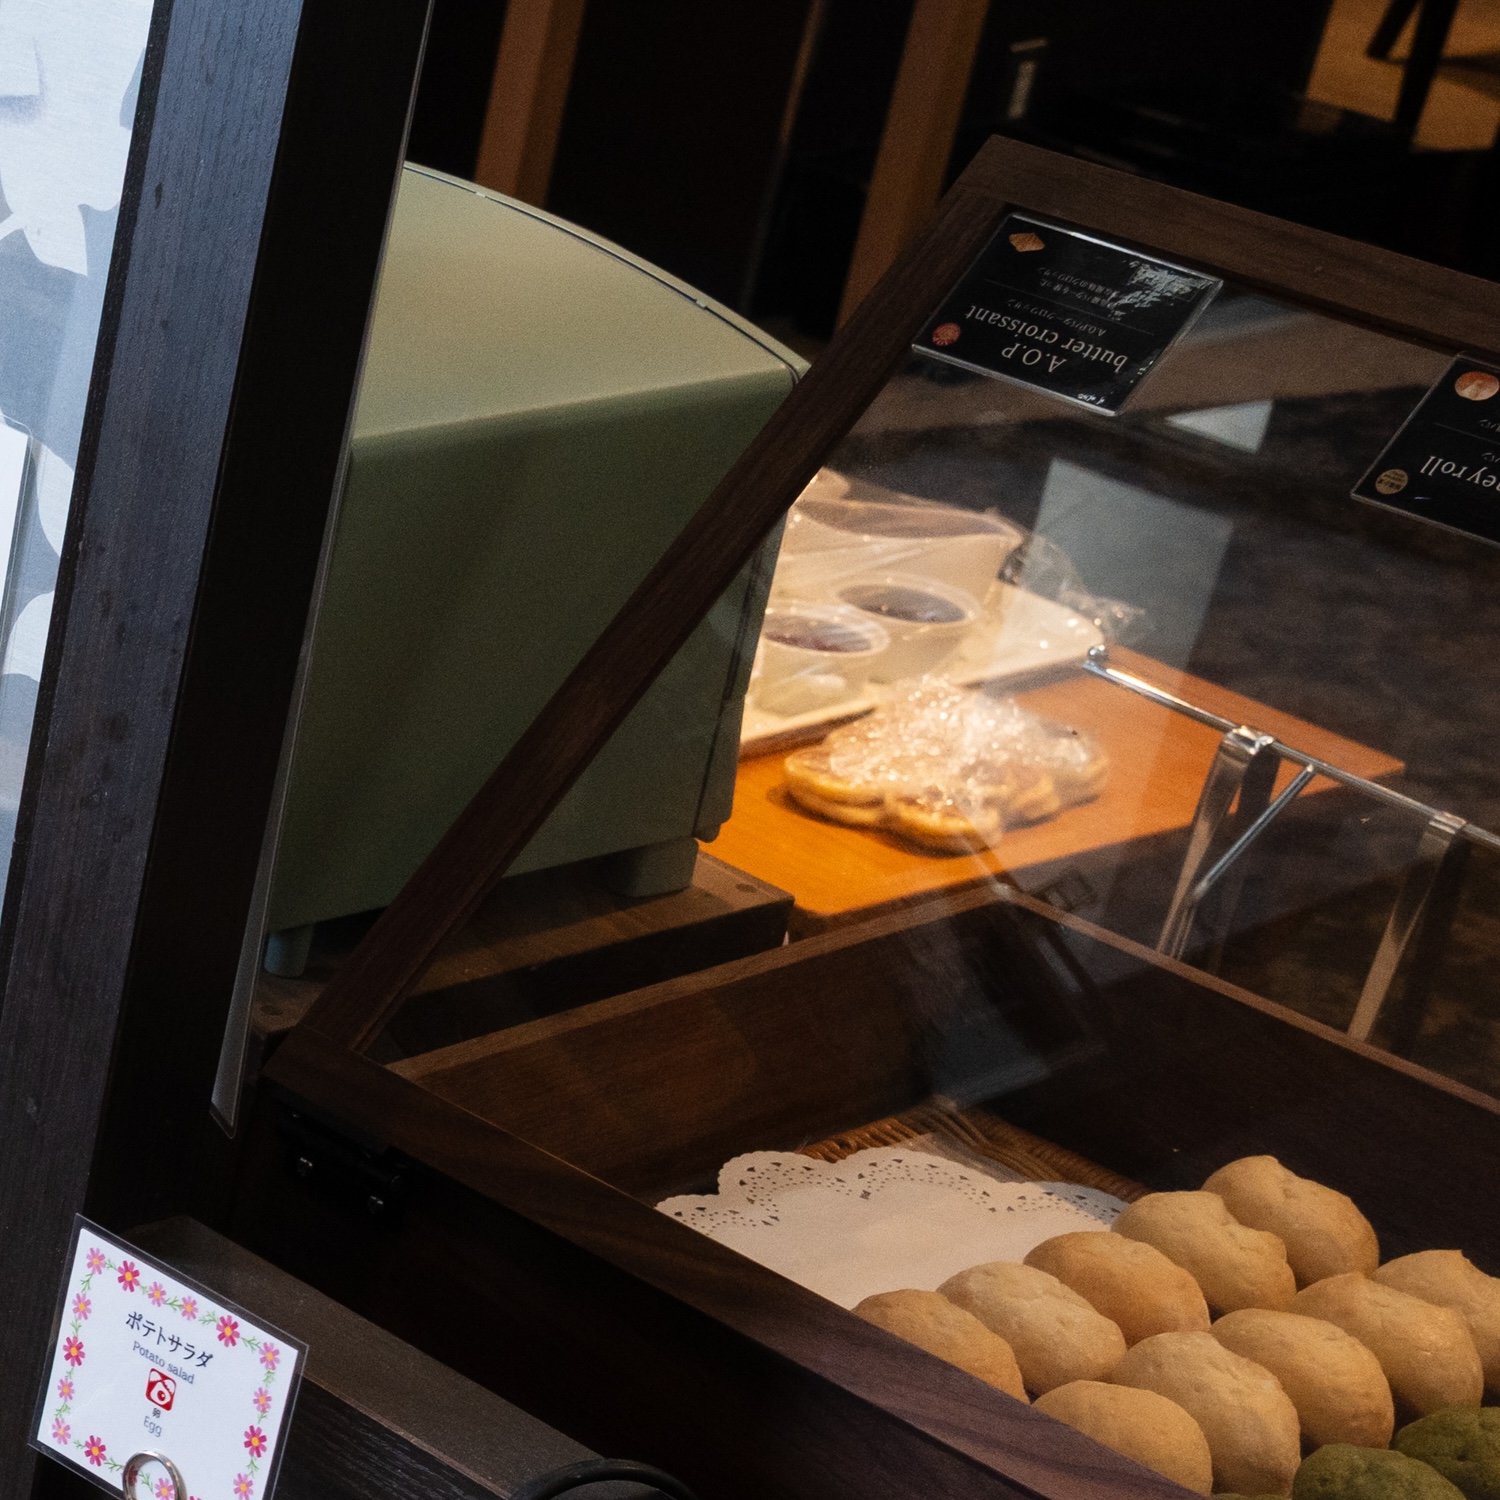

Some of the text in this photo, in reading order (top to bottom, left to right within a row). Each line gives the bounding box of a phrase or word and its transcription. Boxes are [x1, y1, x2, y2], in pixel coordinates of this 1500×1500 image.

[964, 305, 1129, 374] butter croissant
[1001, 342, 1068, 373] A.O.P
[1420, 455, 1468, 479] roll
[125, 1311, 214, 1369] ポテトサラダ
[132, 1341, 194, 1384] Potato salad
[143, 1415, 163, 1438] Egg
